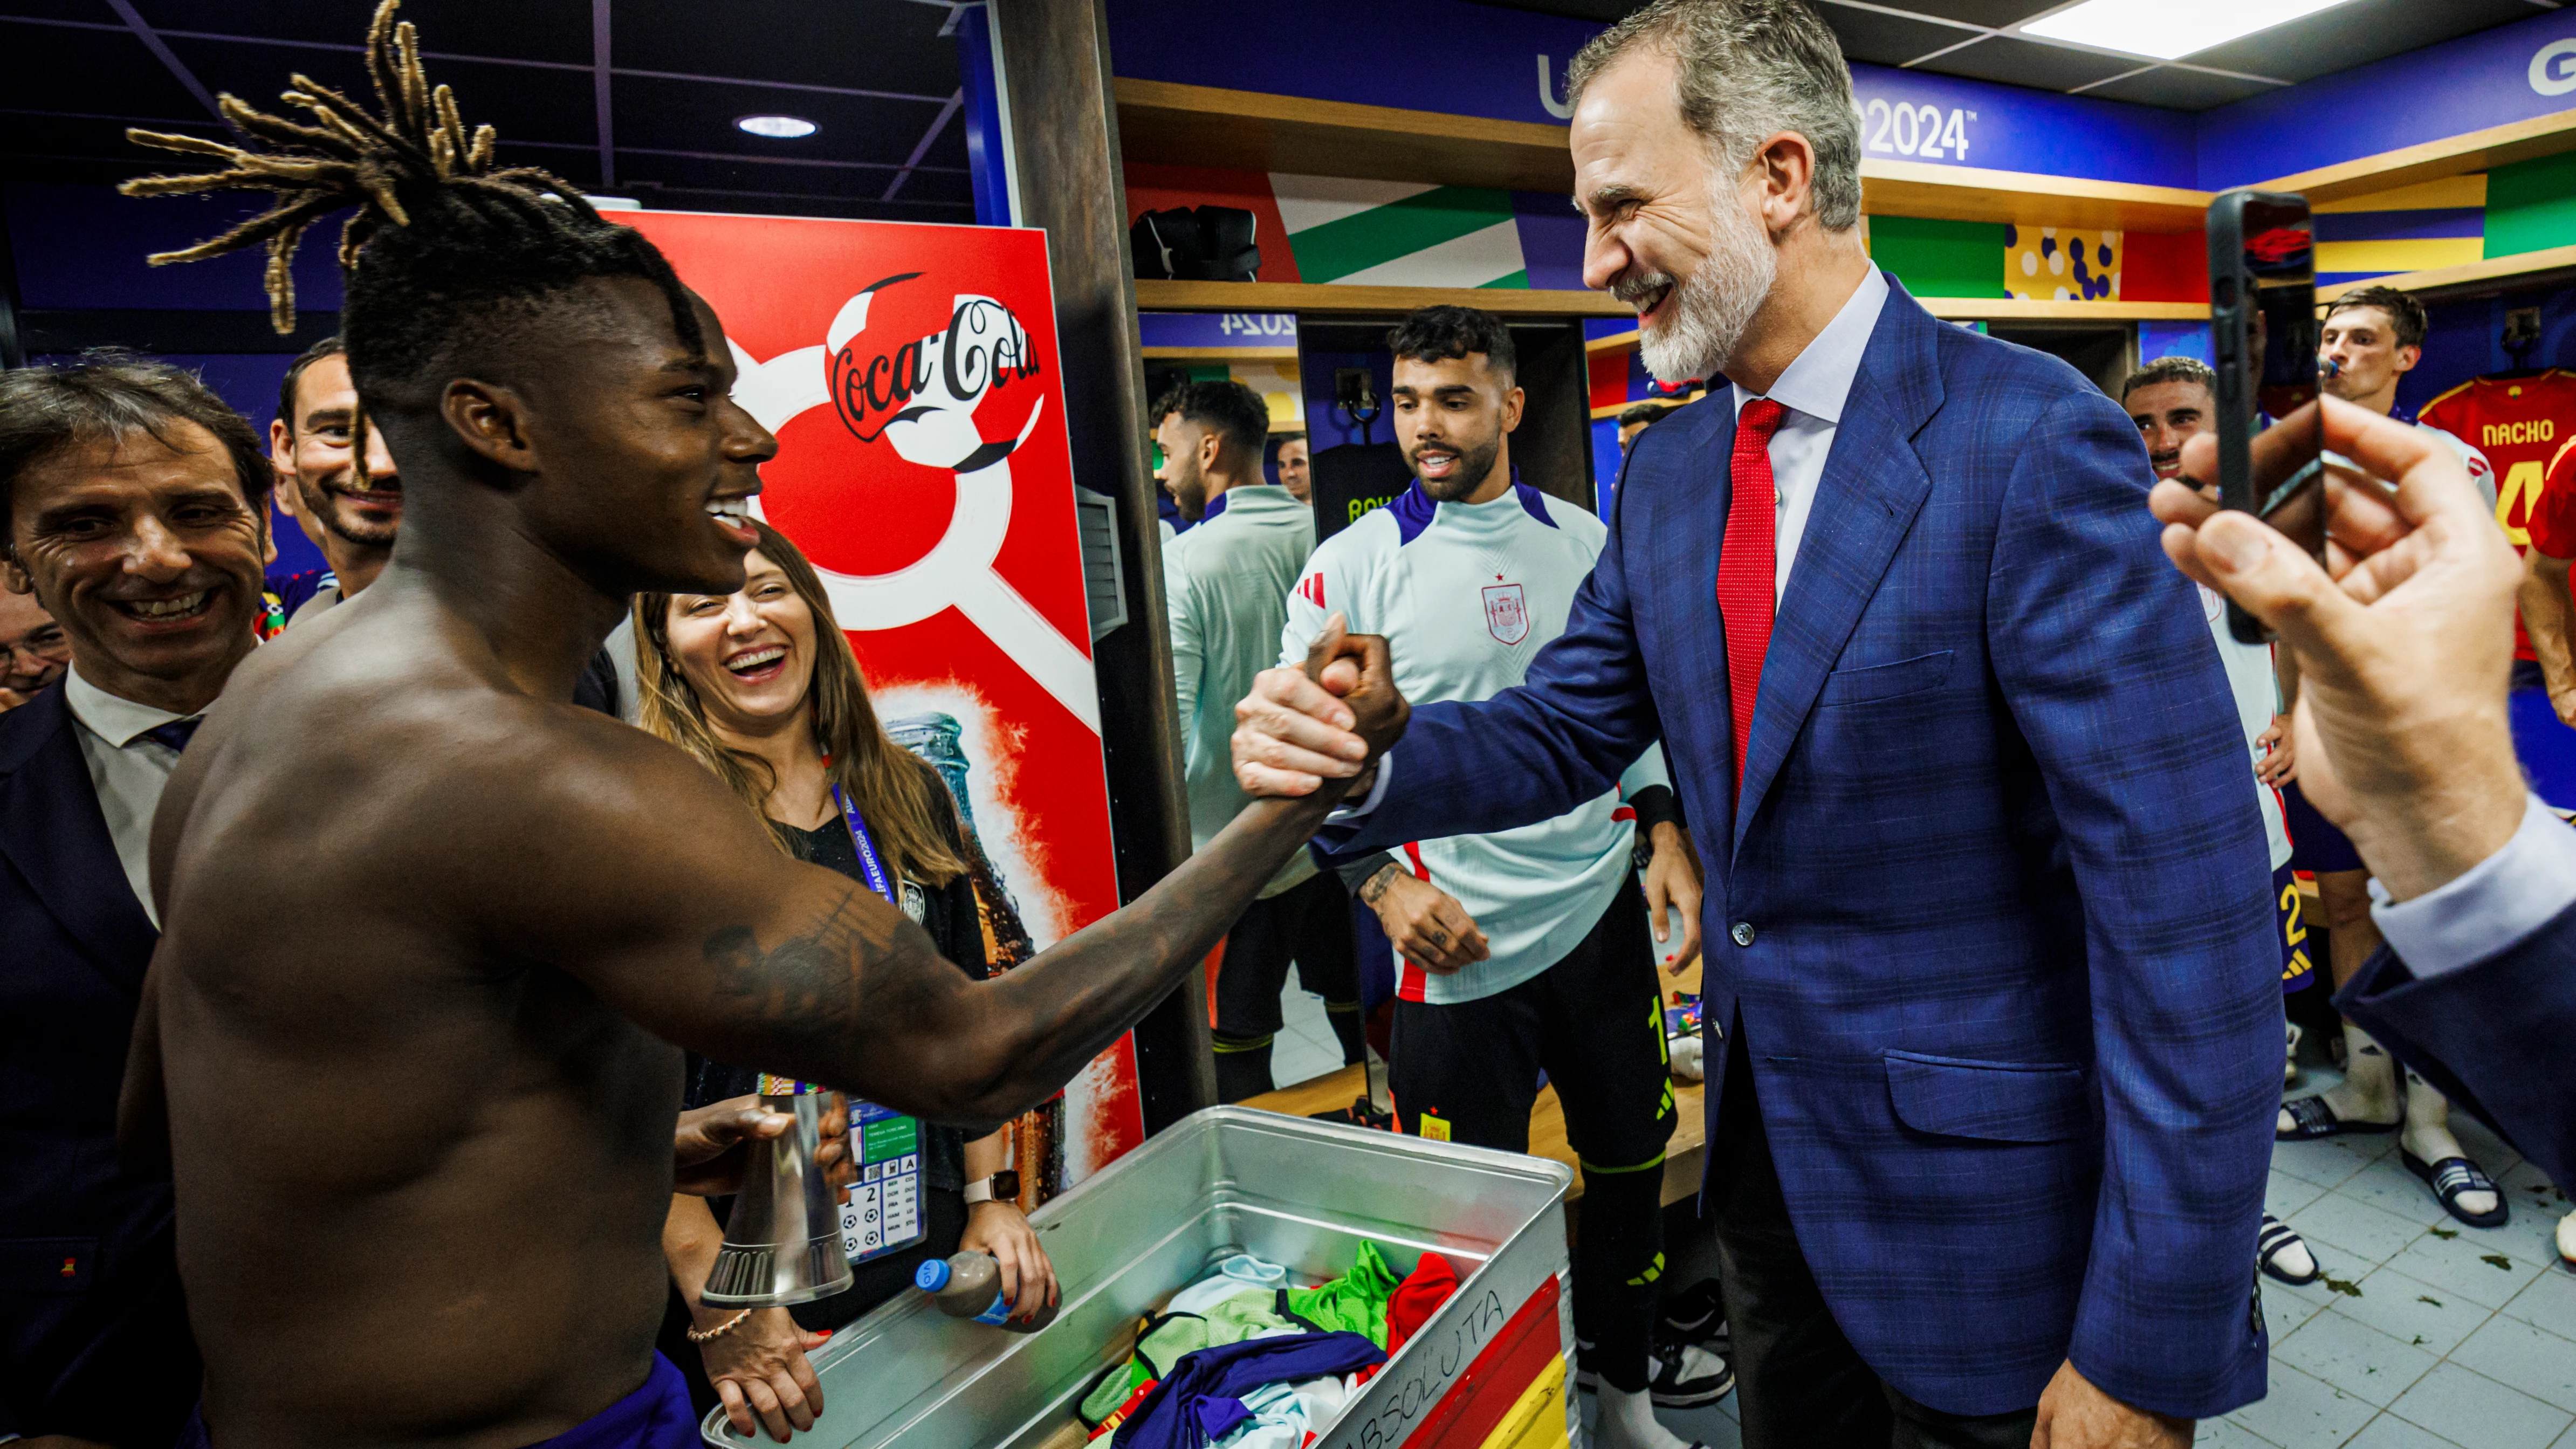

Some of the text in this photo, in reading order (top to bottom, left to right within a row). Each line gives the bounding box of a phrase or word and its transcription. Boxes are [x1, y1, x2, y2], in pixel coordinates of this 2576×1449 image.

[833, 299, 1039, 442] Coca-Cola
[2483, 419, 2554, 447] NACHO
[2495, 461, 2544, 545] 4
[2280, 883, 2306, 946] 2
[867, 1187, 876, 1202] 2
[906, 1159, 914, 1169] A
[1346, 1290, 1503, 1449] BSOLUTA
